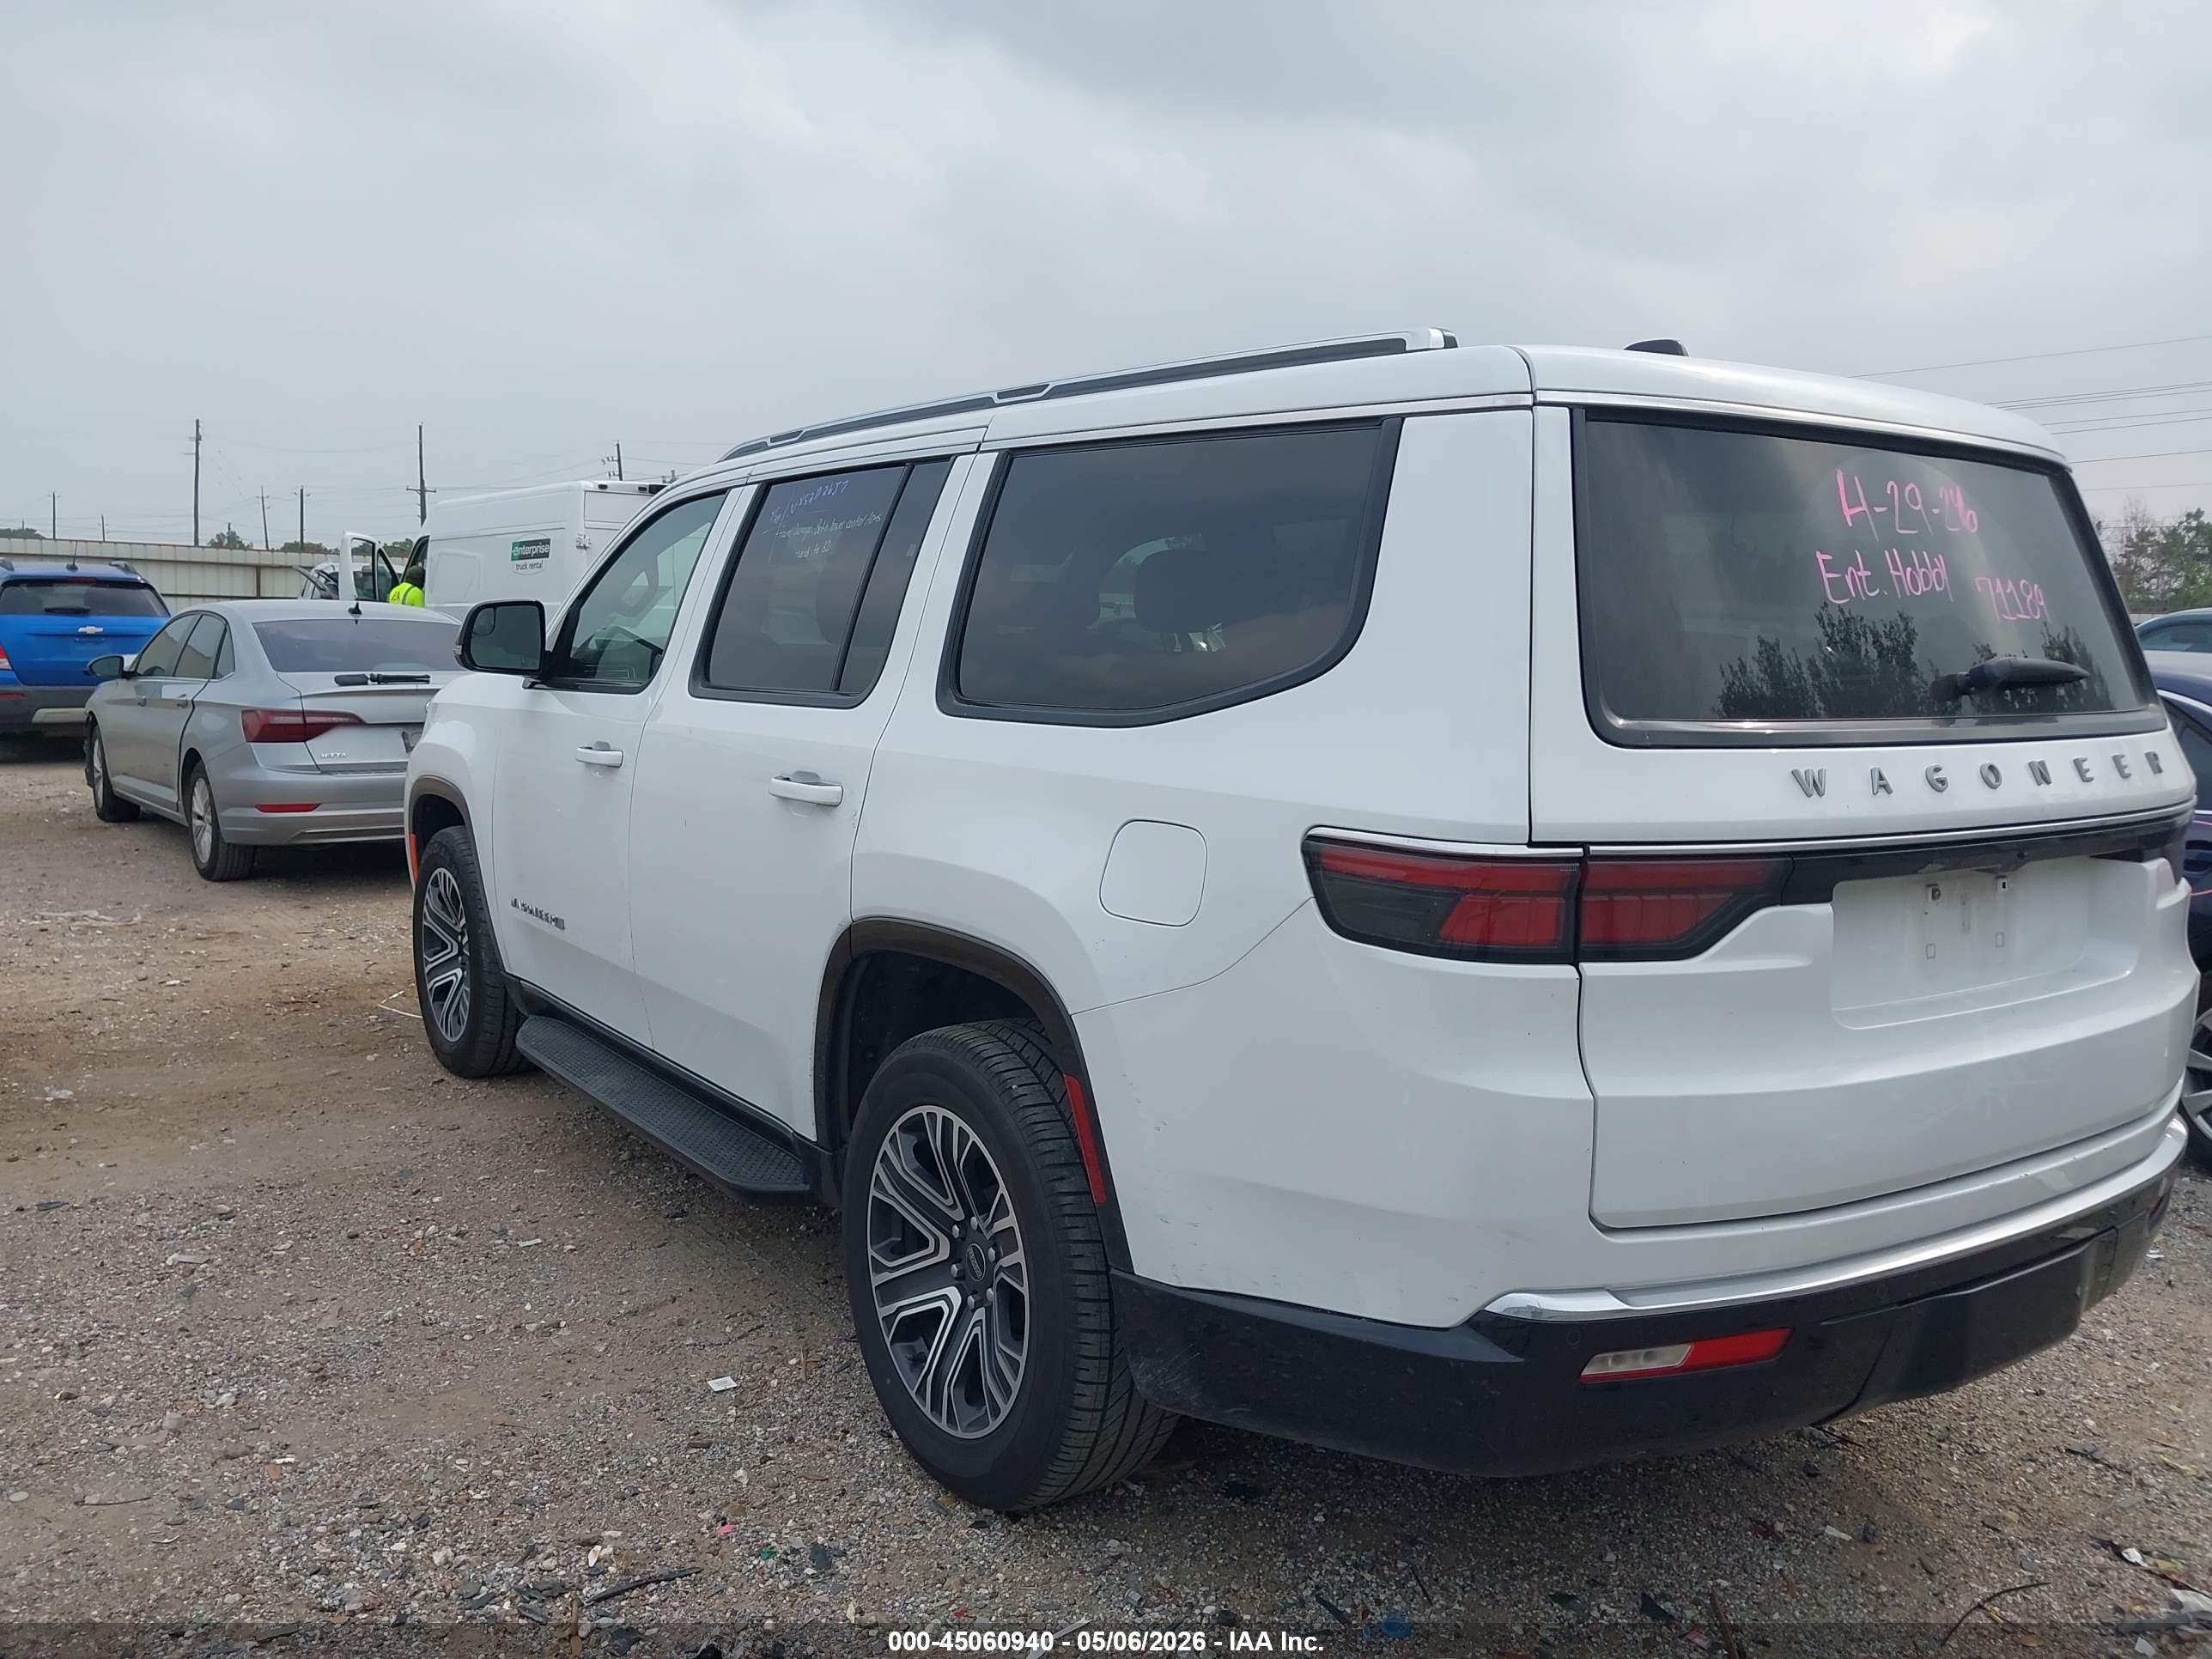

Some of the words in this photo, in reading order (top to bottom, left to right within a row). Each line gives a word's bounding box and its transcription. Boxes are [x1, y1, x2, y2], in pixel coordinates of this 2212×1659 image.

[513, 543, 550, 557] enterprise
[515, 562, 528, 571] truck
[529, 560, 544, 570] rental
[1816, 550, 1888, 605] Ent.
[1790, 750, 2165, 799] WAGONEER
